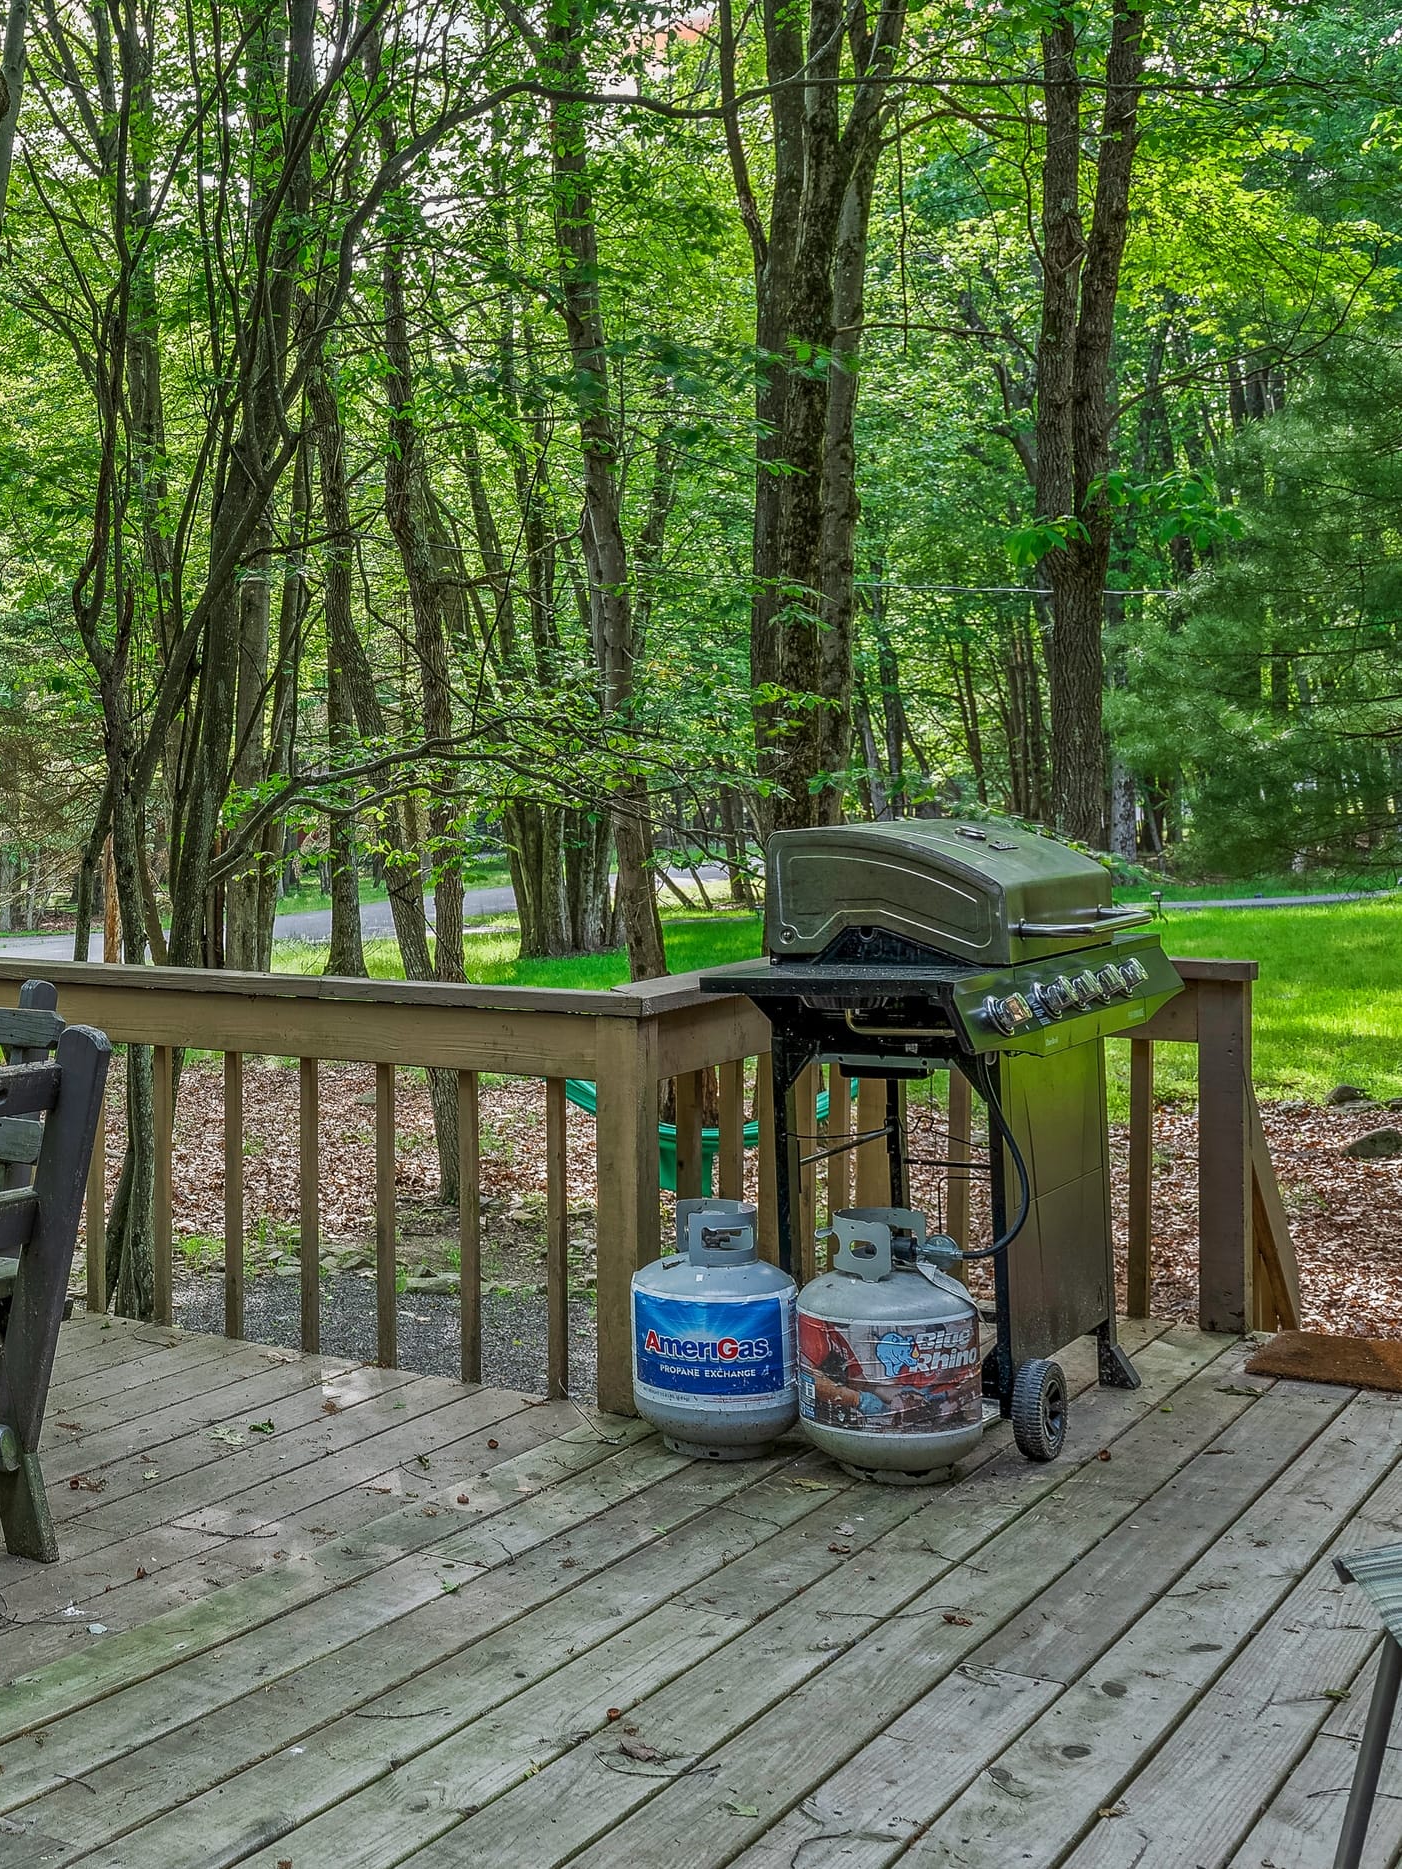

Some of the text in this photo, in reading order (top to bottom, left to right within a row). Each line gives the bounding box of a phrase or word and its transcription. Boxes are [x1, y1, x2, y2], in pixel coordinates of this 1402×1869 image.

[645, 1329, 769, 1362] AmeriGas
[916, 1328, 971, 1351] Blue
[660, 1364, 756, 1378] PROPANE EXCHANGE
[909, 1347, 977, 1372] Rhino
